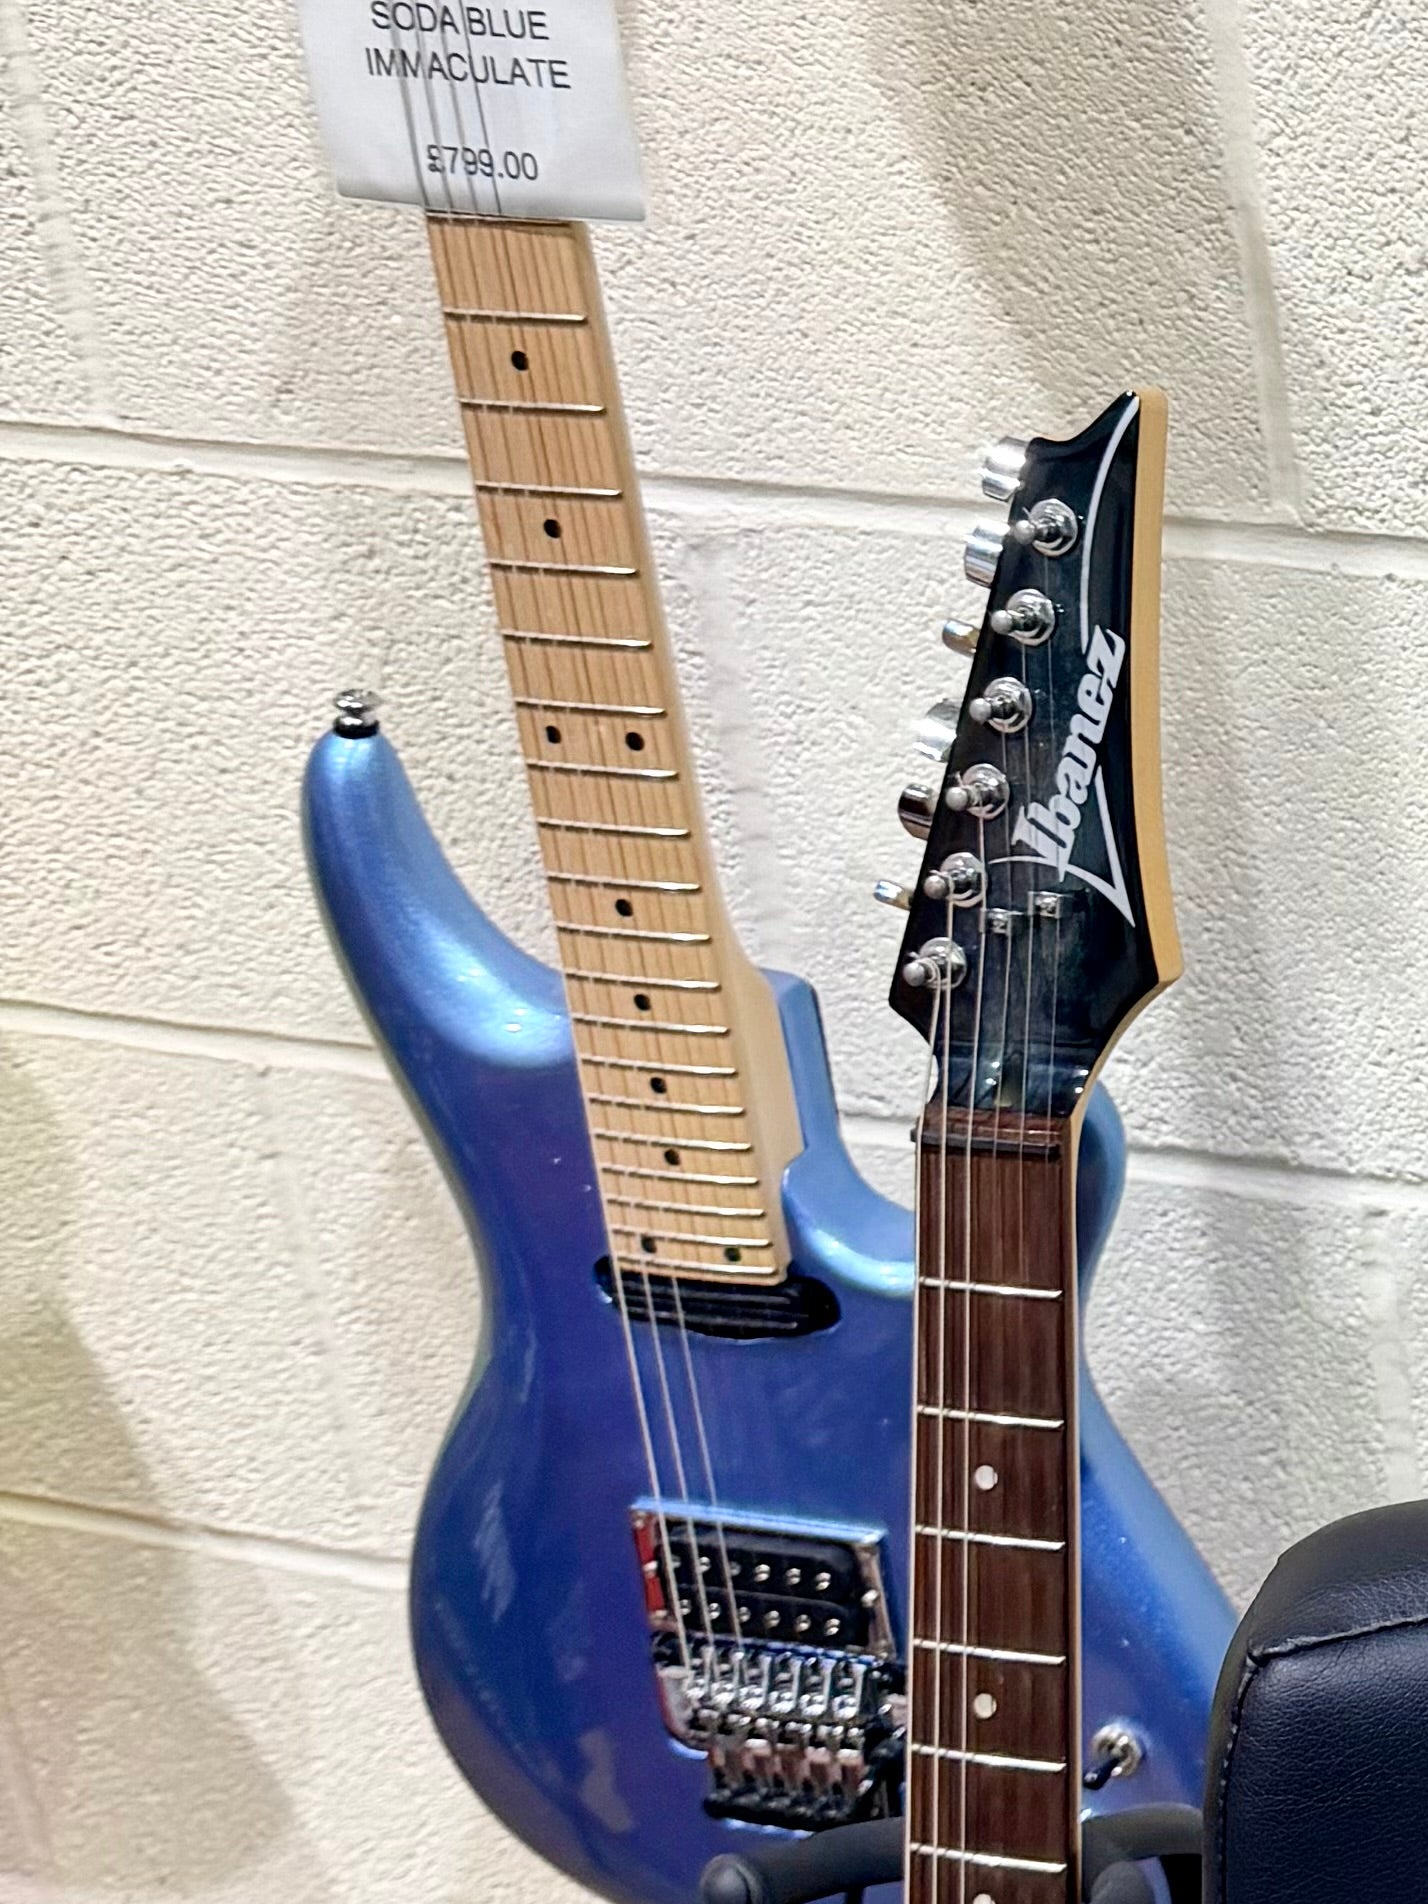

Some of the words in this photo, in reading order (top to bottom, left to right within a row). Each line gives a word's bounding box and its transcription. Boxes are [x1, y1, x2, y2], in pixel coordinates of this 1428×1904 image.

[370, 0, 461, 36] SODA
[465, 6, 550, 41] BLUE
[364, 47, 572, 90] IMMACULATE
[426, 144, 539, 181] £799.00
[1010, 624, 1127, 884] Ibanez
